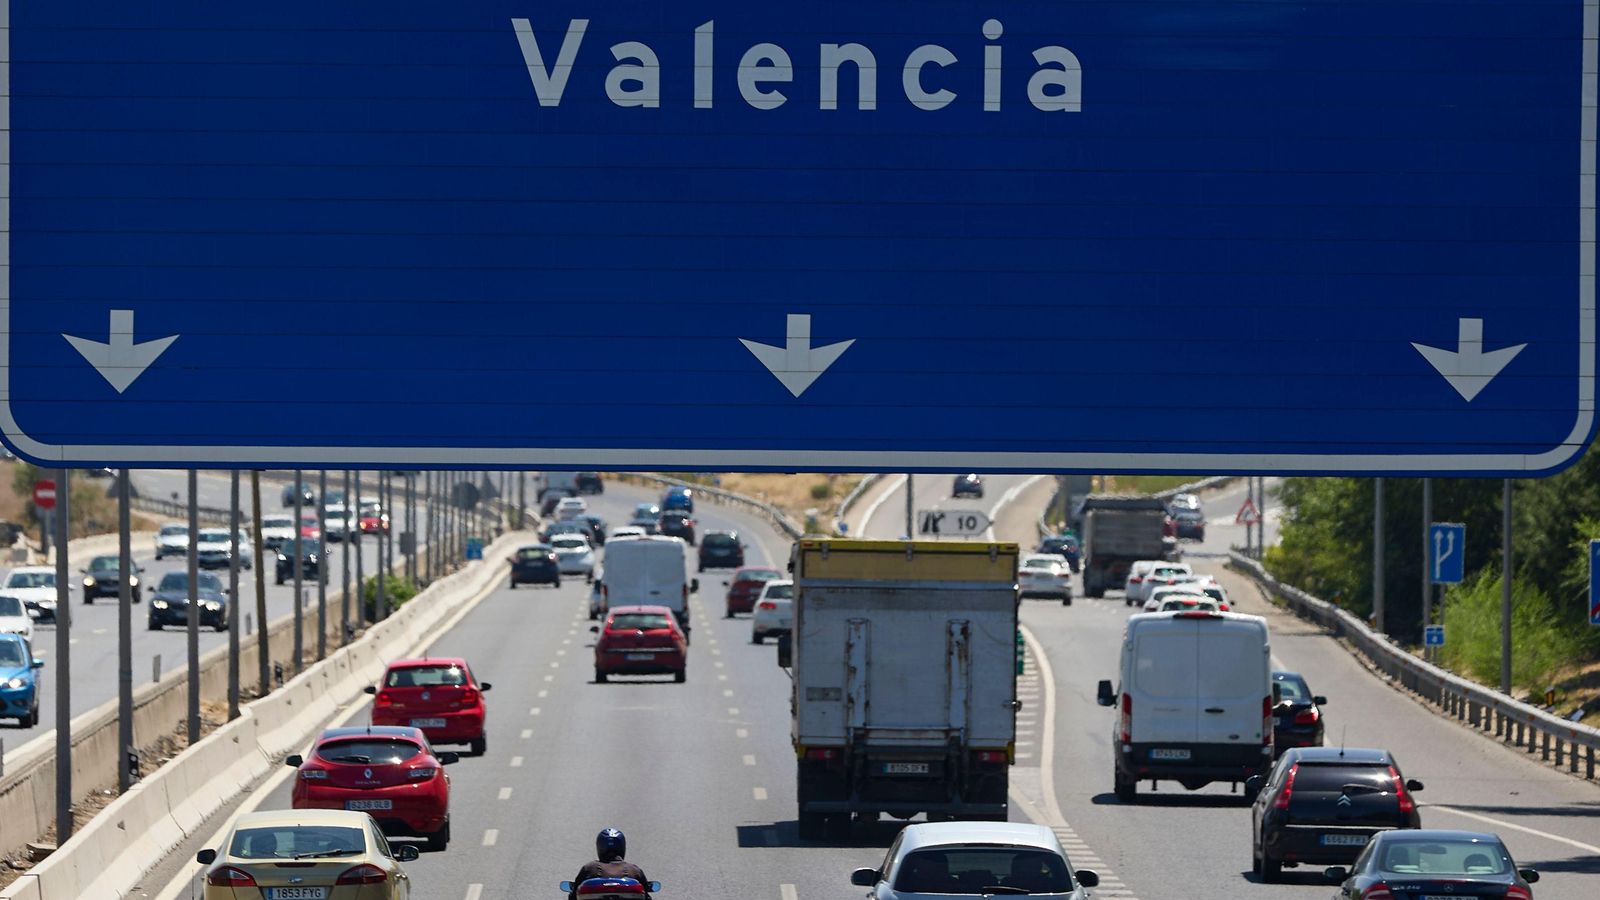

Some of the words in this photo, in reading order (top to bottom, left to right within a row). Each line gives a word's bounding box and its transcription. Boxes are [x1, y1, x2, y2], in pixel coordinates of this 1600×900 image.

[510, 18, 1082, 112] Valencia
[958, 516, 977, 530] 10
[276, 888, 300, 899] 1853
[302, 888, 321, 898] FYG
